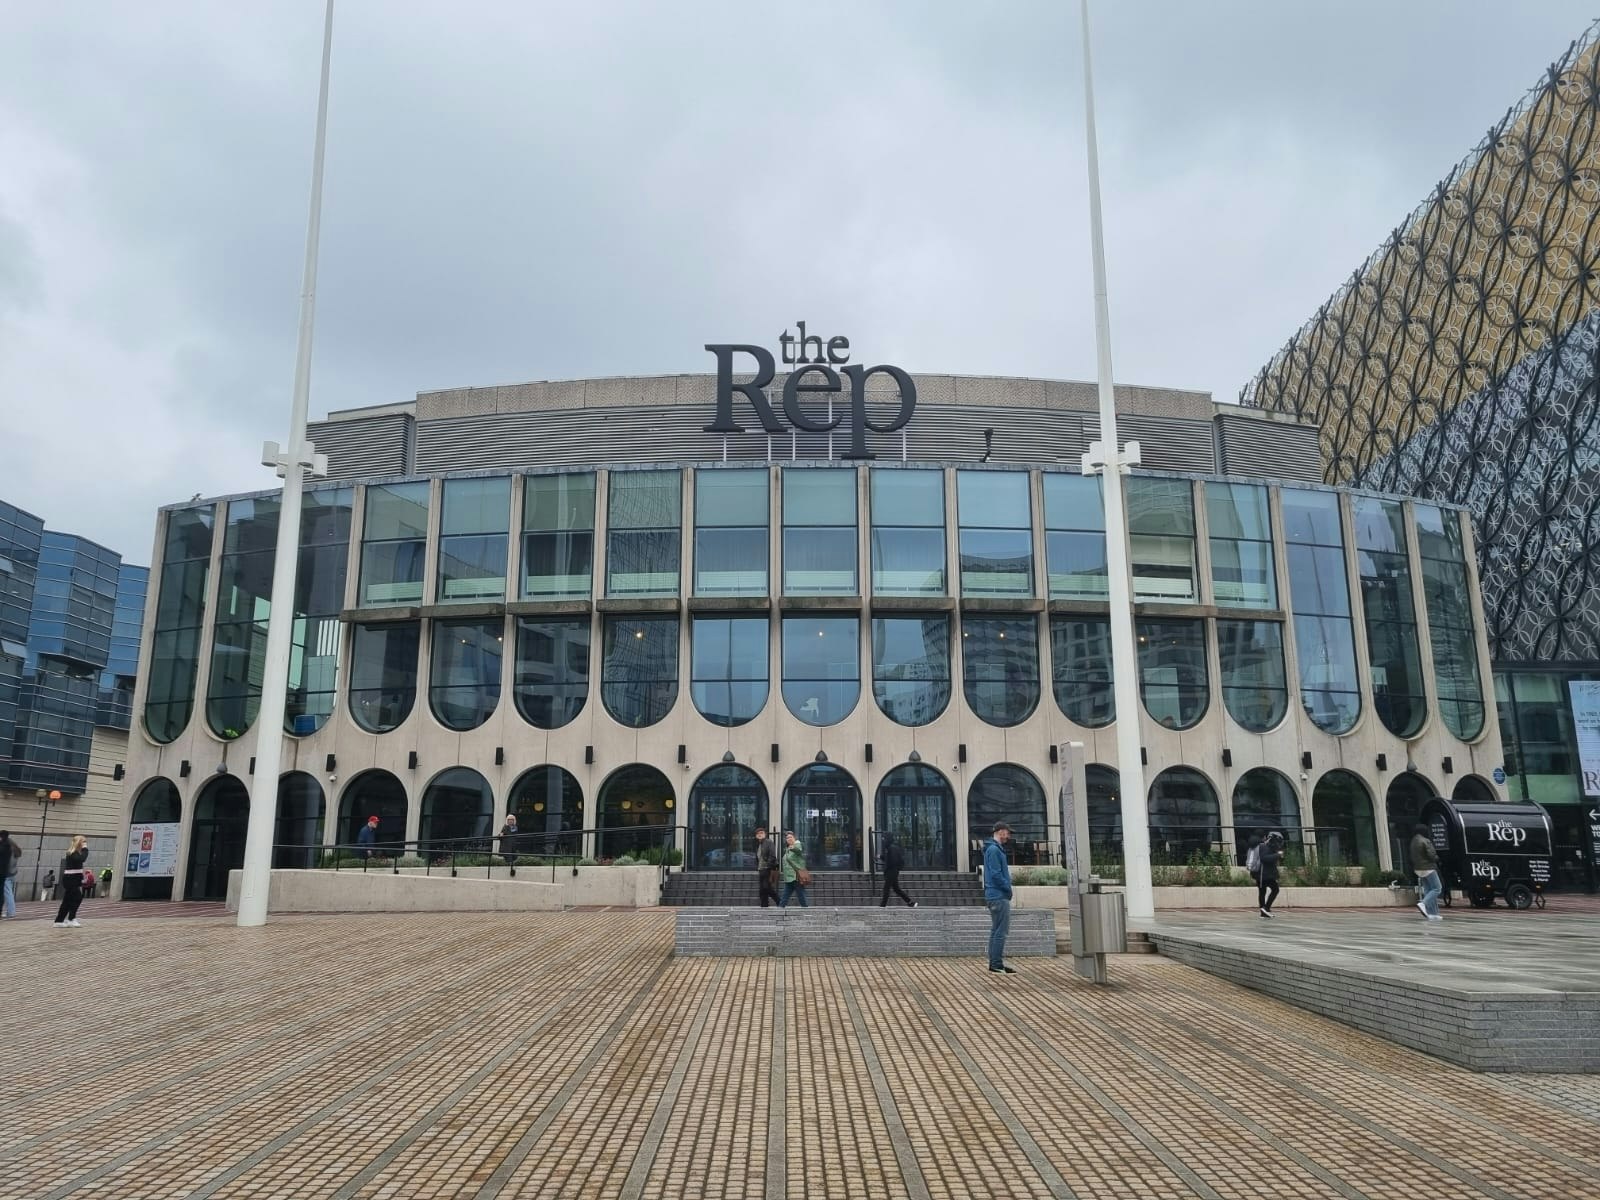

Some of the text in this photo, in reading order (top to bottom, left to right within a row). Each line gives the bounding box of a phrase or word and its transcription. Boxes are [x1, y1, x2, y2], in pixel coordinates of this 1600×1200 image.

[779, 321, 850, 364] the
[703, 344, 917, 460] Rep
[1486, 822, 1526, 846] Rep
[1498, 820, 1513, 828] the
[1471, 862, 1500, 880] Rep
